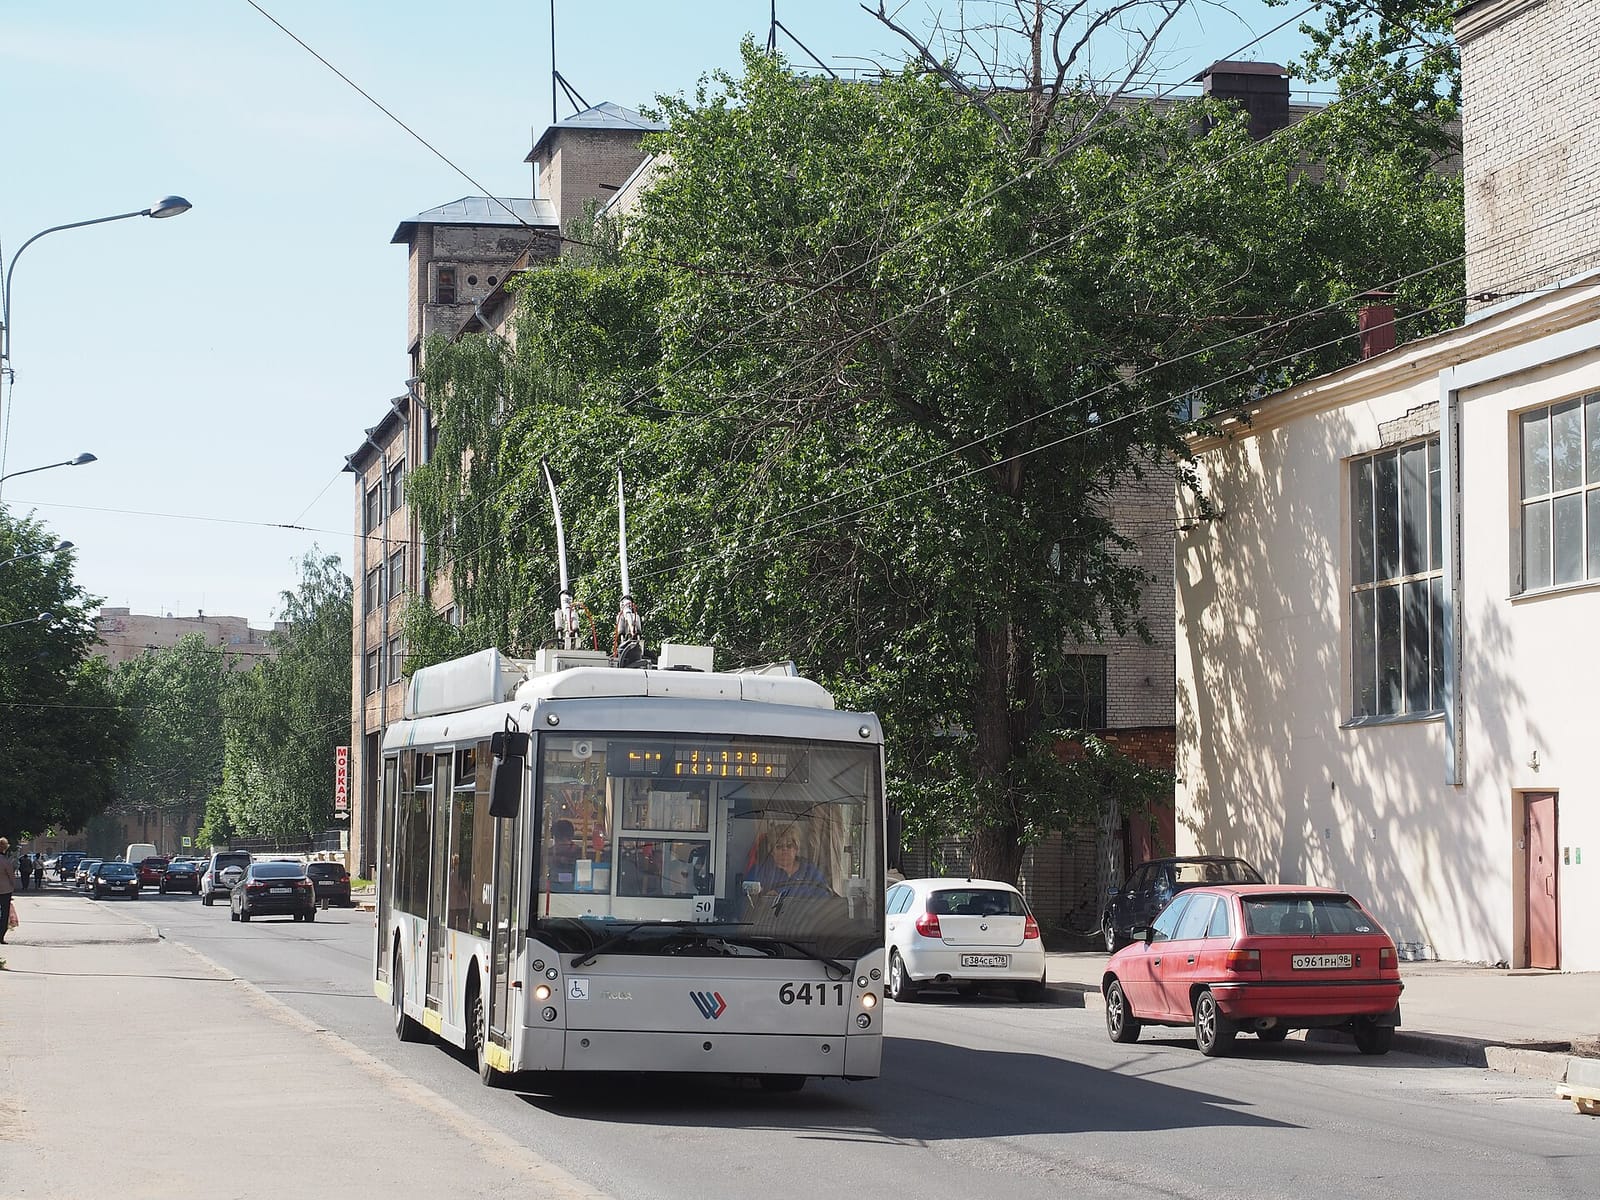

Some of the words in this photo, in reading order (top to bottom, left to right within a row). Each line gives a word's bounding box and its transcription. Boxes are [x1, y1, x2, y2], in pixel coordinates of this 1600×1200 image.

[338, 749, 347, 793] МОЙКА
[695, 901, 711, 913] 50
[779, 982, 843, 1006] 6411
